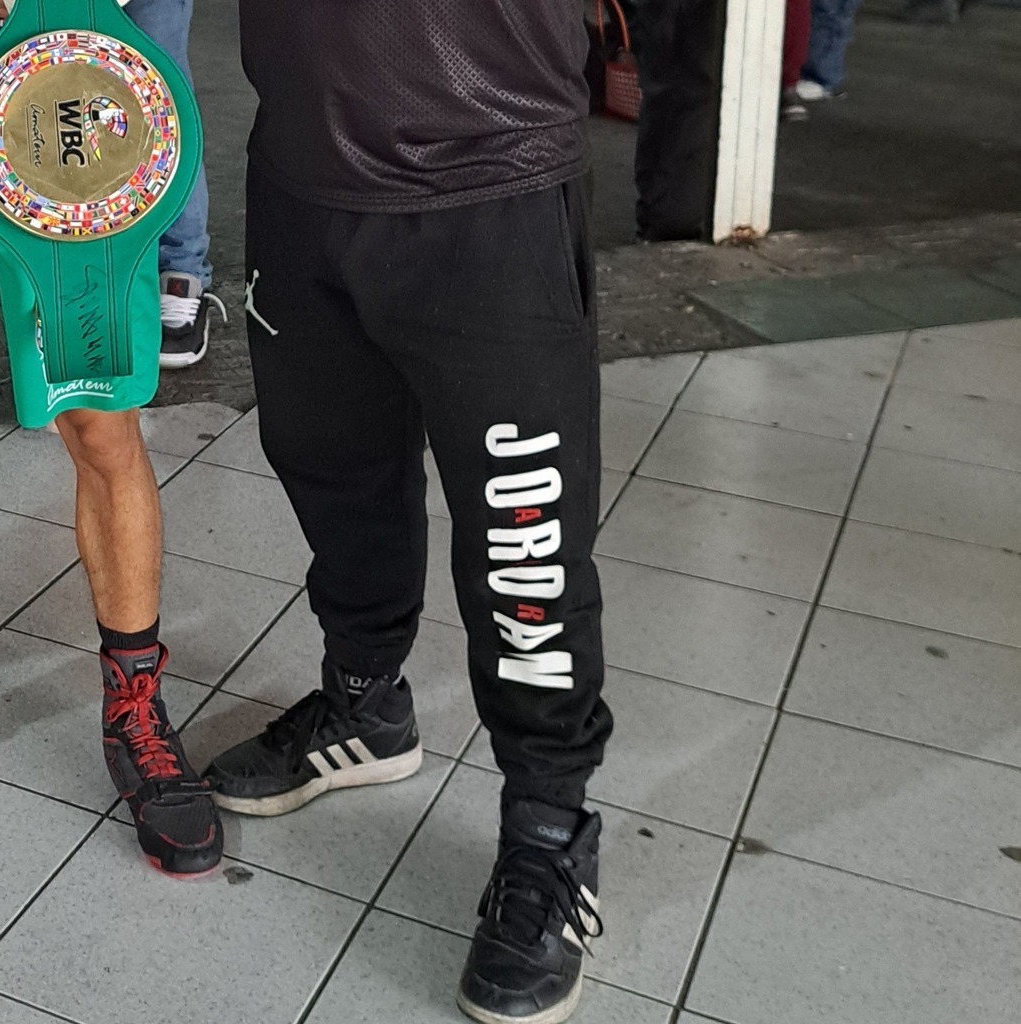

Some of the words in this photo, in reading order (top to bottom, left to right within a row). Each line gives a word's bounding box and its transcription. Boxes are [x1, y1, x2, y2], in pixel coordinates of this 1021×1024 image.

[58, 100, 85, 166] WBC
[48, 379, 113, 405] Amateur
[485, 423, 574, 689] JORDAN
